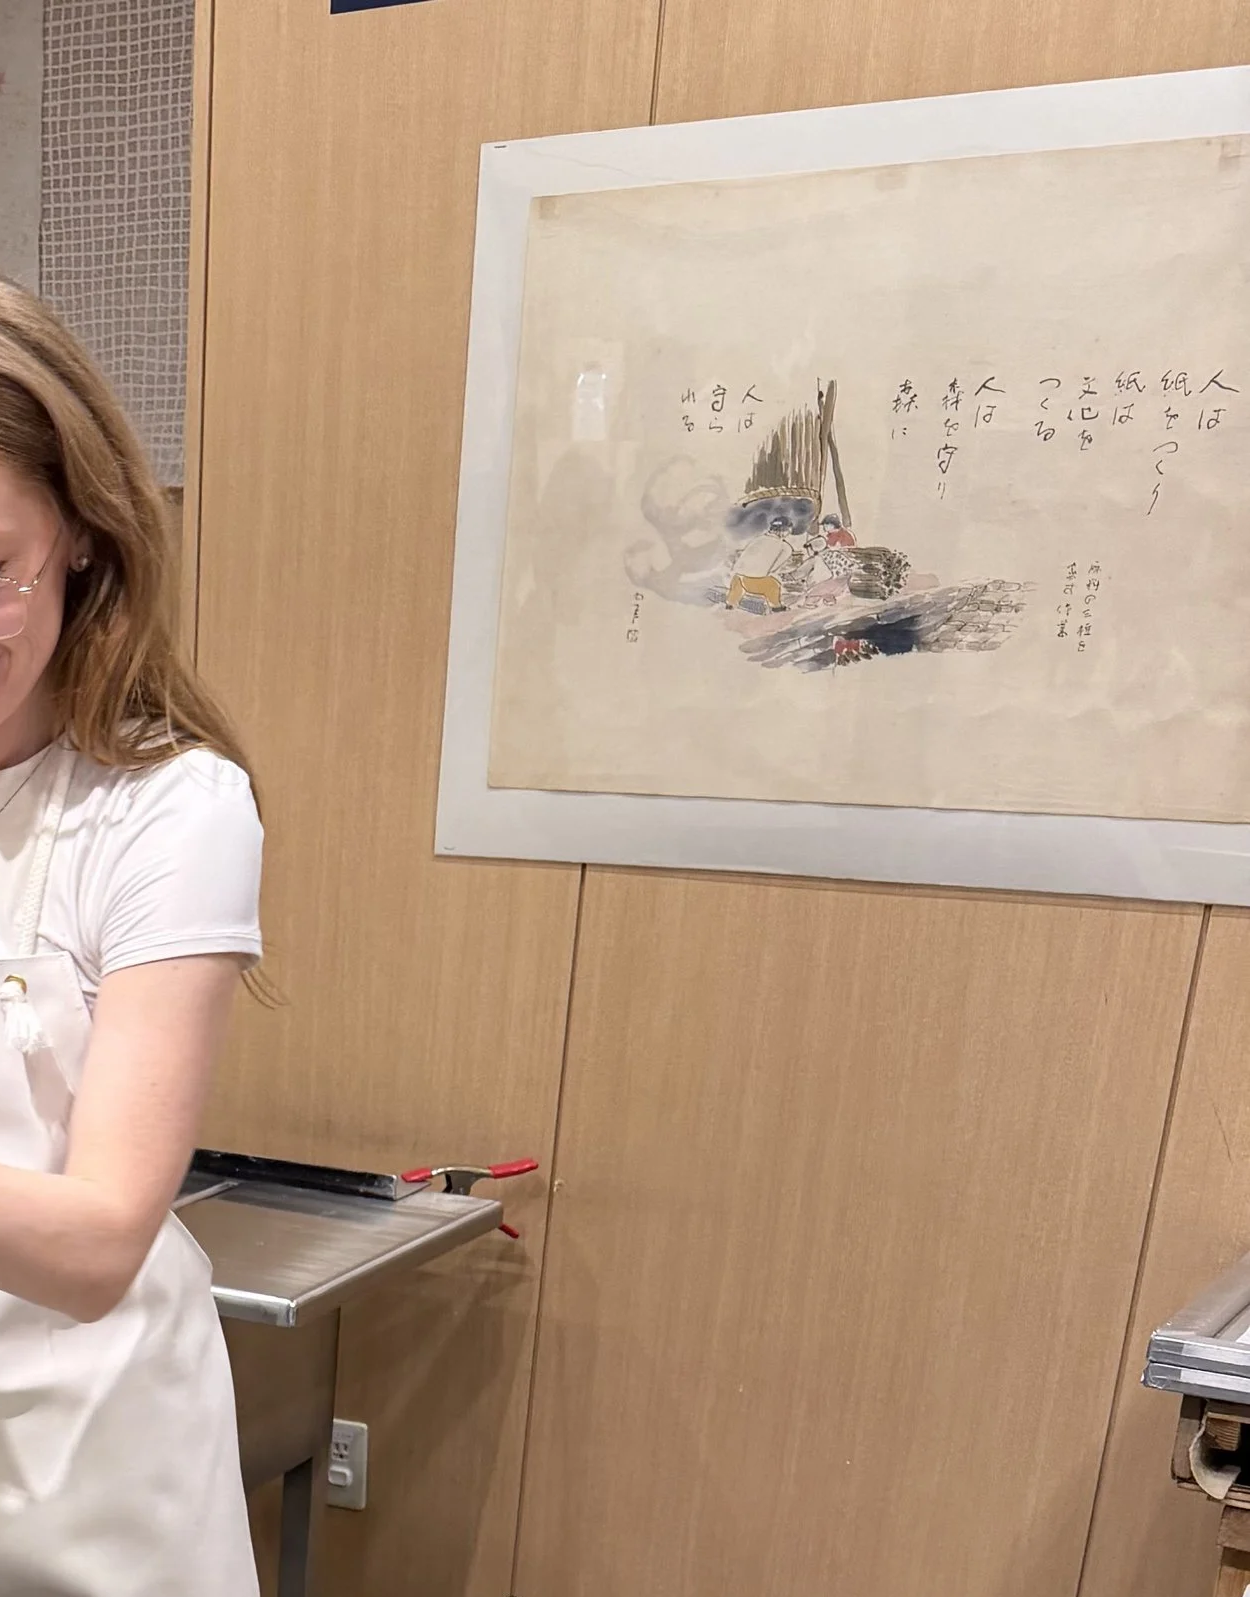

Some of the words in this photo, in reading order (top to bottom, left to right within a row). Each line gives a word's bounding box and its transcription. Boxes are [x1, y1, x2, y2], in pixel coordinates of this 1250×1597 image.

[737, 384, 764, 433] 人は
[974, 376, 1006, 428] 人は
[1035, 378, 1061, 441] つくる
[1067, 376, 1099, 450] 文化を
[1111, 371, 1146, 425] 紙は
[1198, 369, 1240, 430] 人は
[1146, 370, 1192, 515] 紙をつくり
